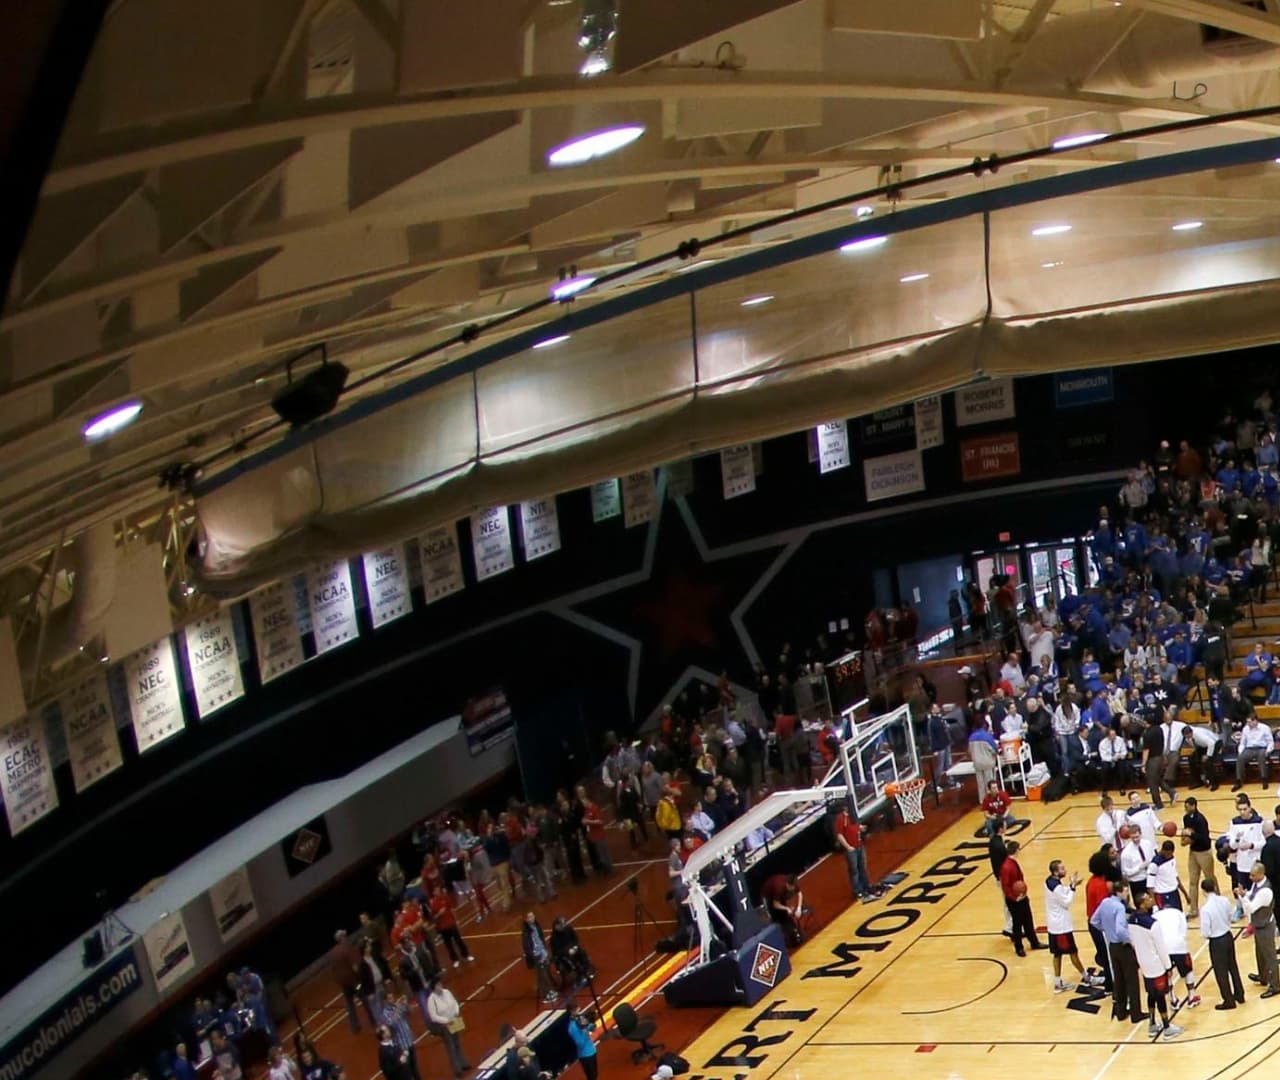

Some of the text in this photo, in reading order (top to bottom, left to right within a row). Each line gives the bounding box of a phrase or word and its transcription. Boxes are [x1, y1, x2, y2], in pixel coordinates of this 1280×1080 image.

[965, 400, 1006, 415] MORRIS
[480, 518, 501, 536] NEC
[375, 560, 399, 578] NEC
[314, 582, 348, 605] NCAA
[194, 636, 232, 664] NCAA
[138, 670, 166, 695] NEC
[4, 740, 41, 771] ECAC
[7, 756, 43, 783] METRO
